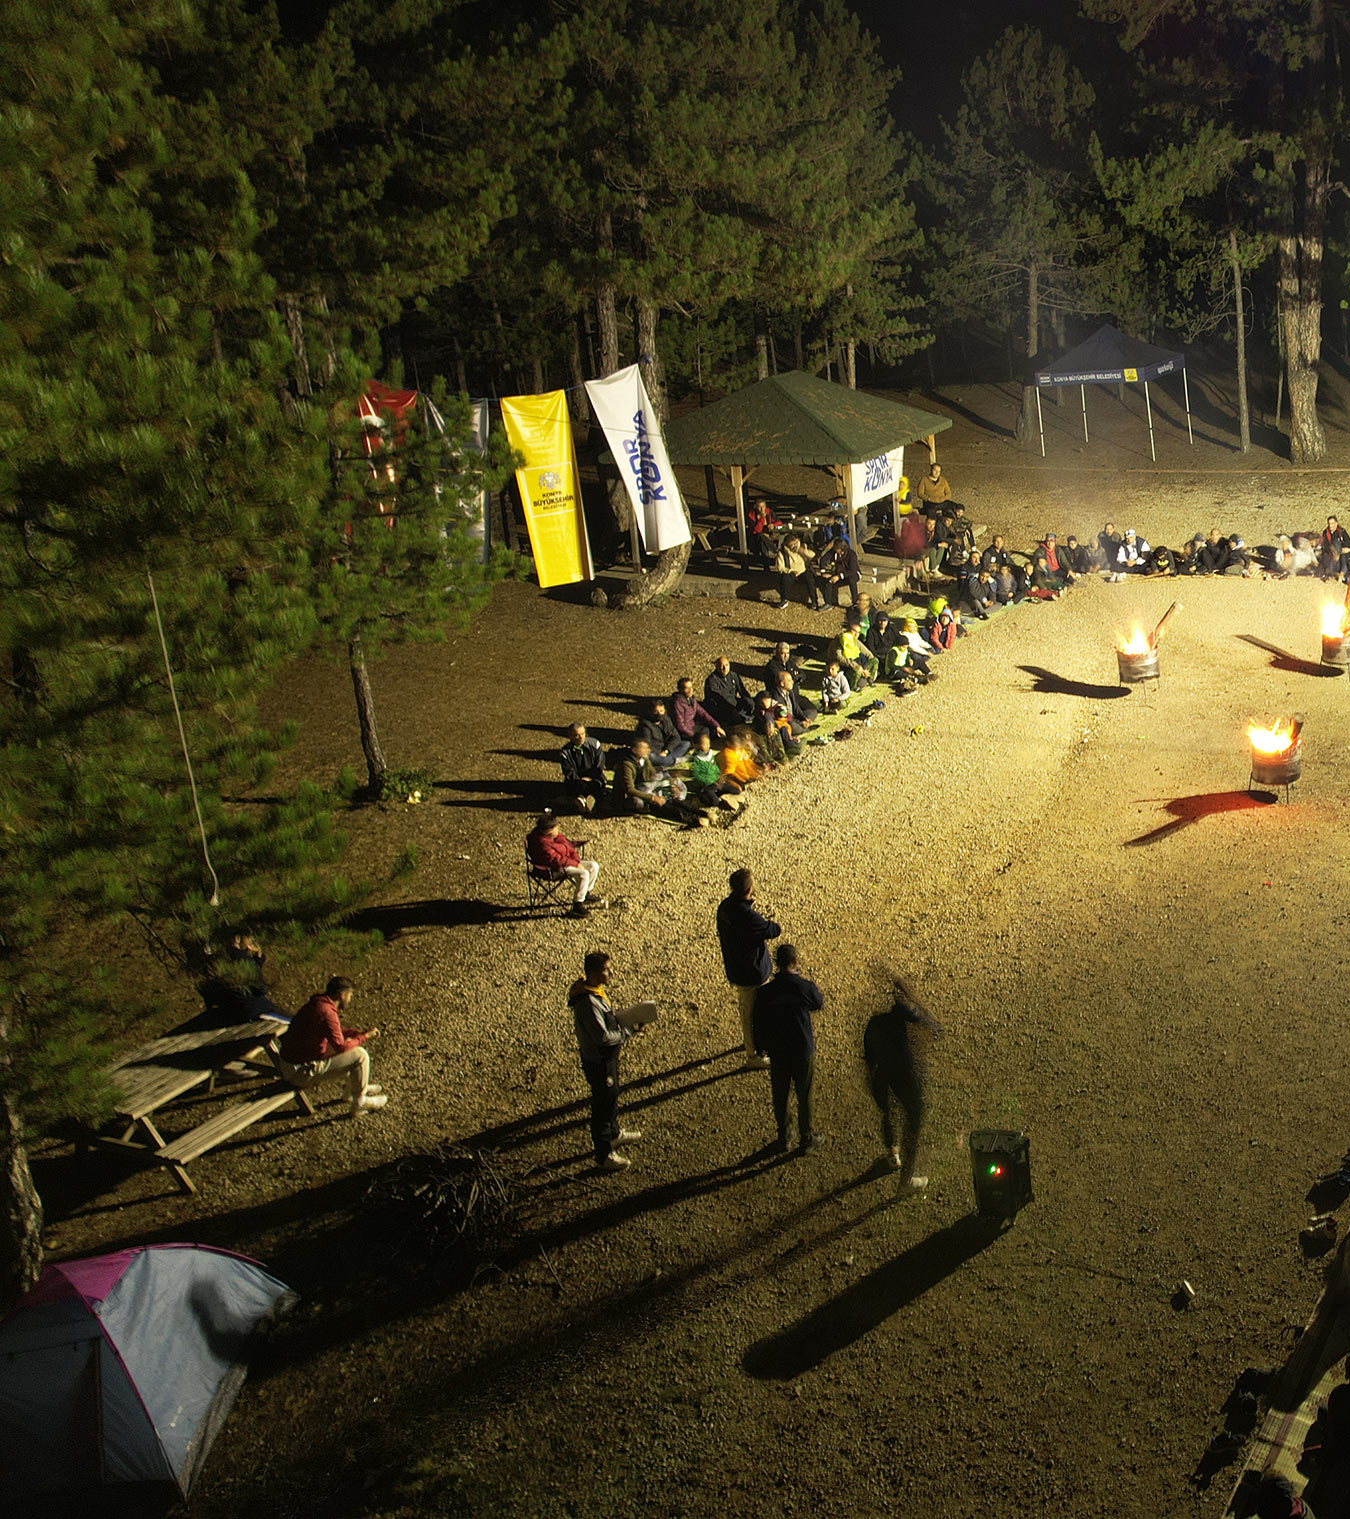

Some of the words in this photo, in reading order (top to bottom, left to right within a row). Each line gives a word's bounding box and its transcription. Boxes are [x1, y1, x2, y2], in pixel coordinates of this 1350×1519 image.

[622, 438, 650, 504] SPOR
[632, 409, 667, 501] KONYA
[542, 490, 563, 499] KONYA
